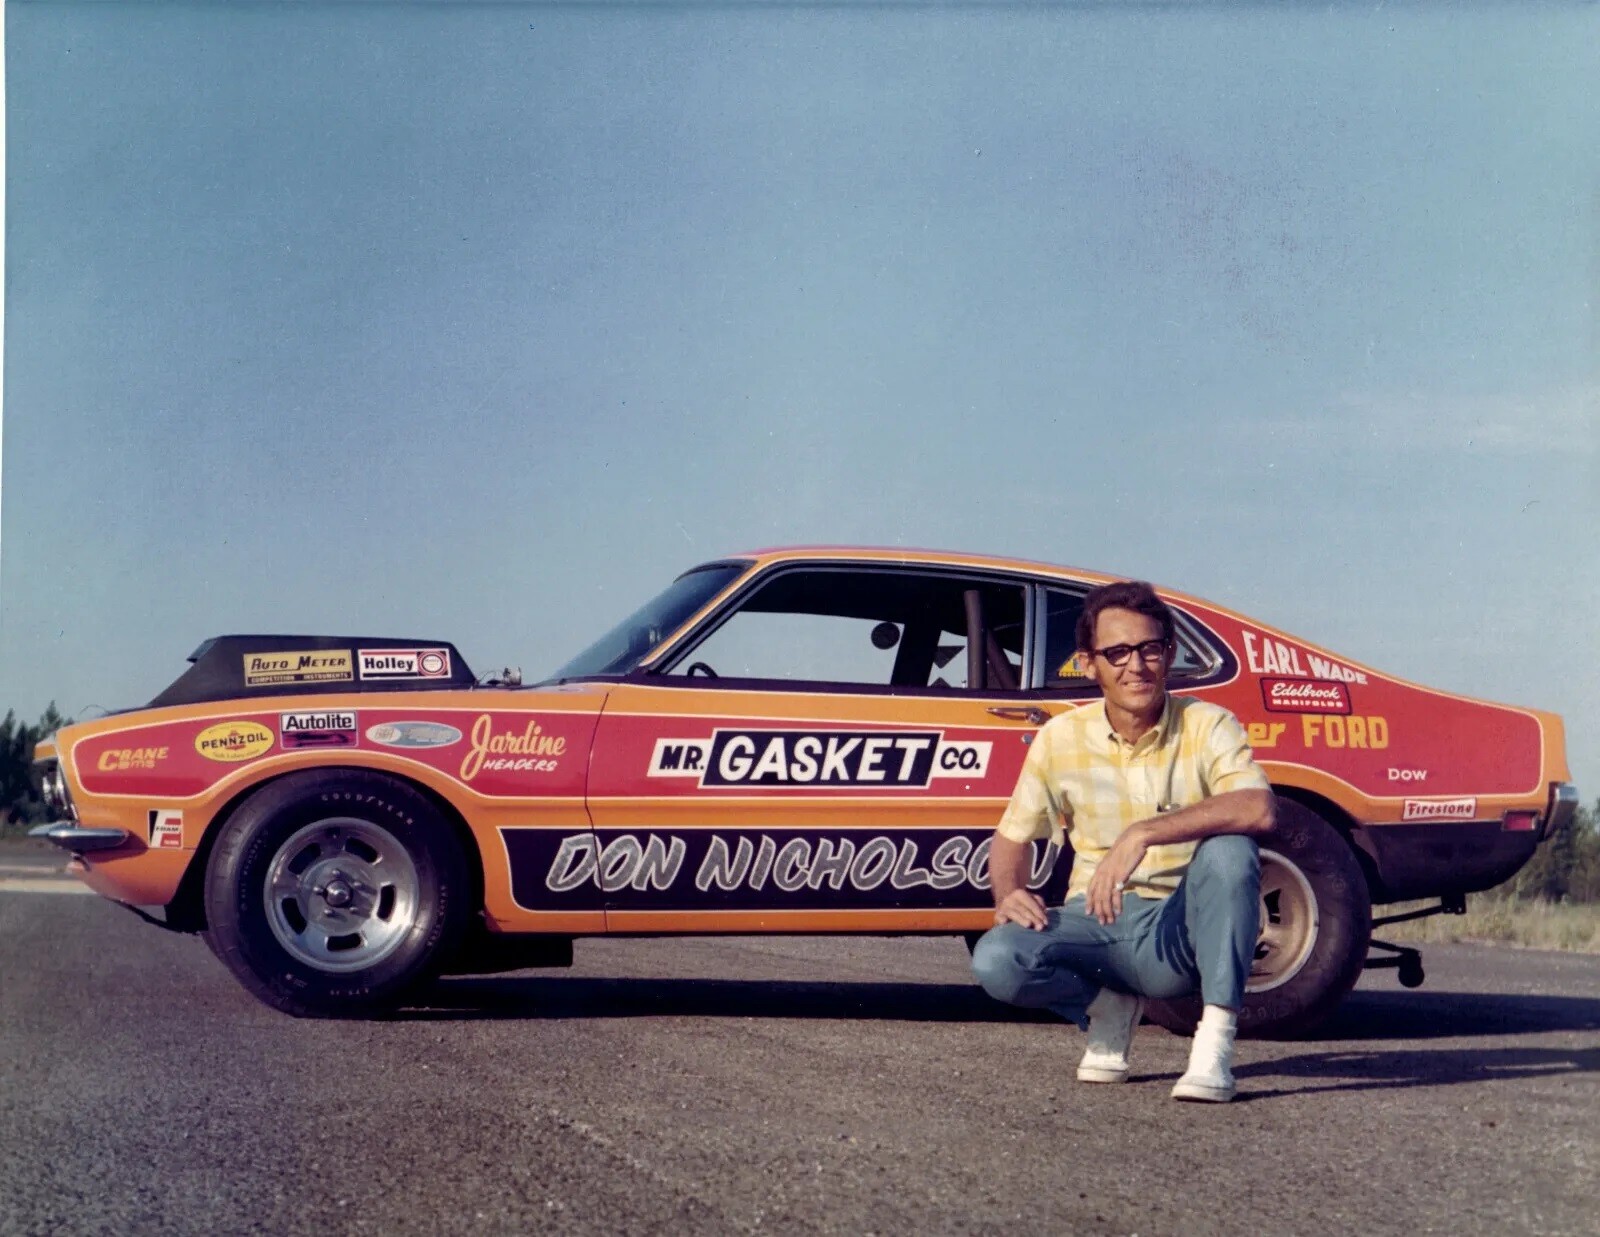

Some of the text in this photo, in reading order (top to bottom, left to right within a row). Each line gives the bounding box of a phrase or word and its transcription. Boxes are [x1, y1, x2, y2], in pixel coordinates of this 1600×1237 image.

[251, 656, 346, 670] AUTO METER
[364, 658, 414, 671] Holley
[1242, 630, 1368, 685] EARL WADE
[1271, 683, 1341, 699] Edelbrock
[1272, 699, 1344, 707] MANIFOLDS
[286, 715, 352, 729] Autolite
[1241, 714, 1389, 749] er FORD
[201, 732, 269, 750] PENNZOIL
[460, 713, 567, 781] Jardine
[98, 747, 169, 771] CRANE
[483, 758, 558, 772] HEADERS
[658, 735, 981, 782] MR. GASKET CO.
[1408, 802, 1473, 816] Firestone
[546, 833, 687, 892] DON
